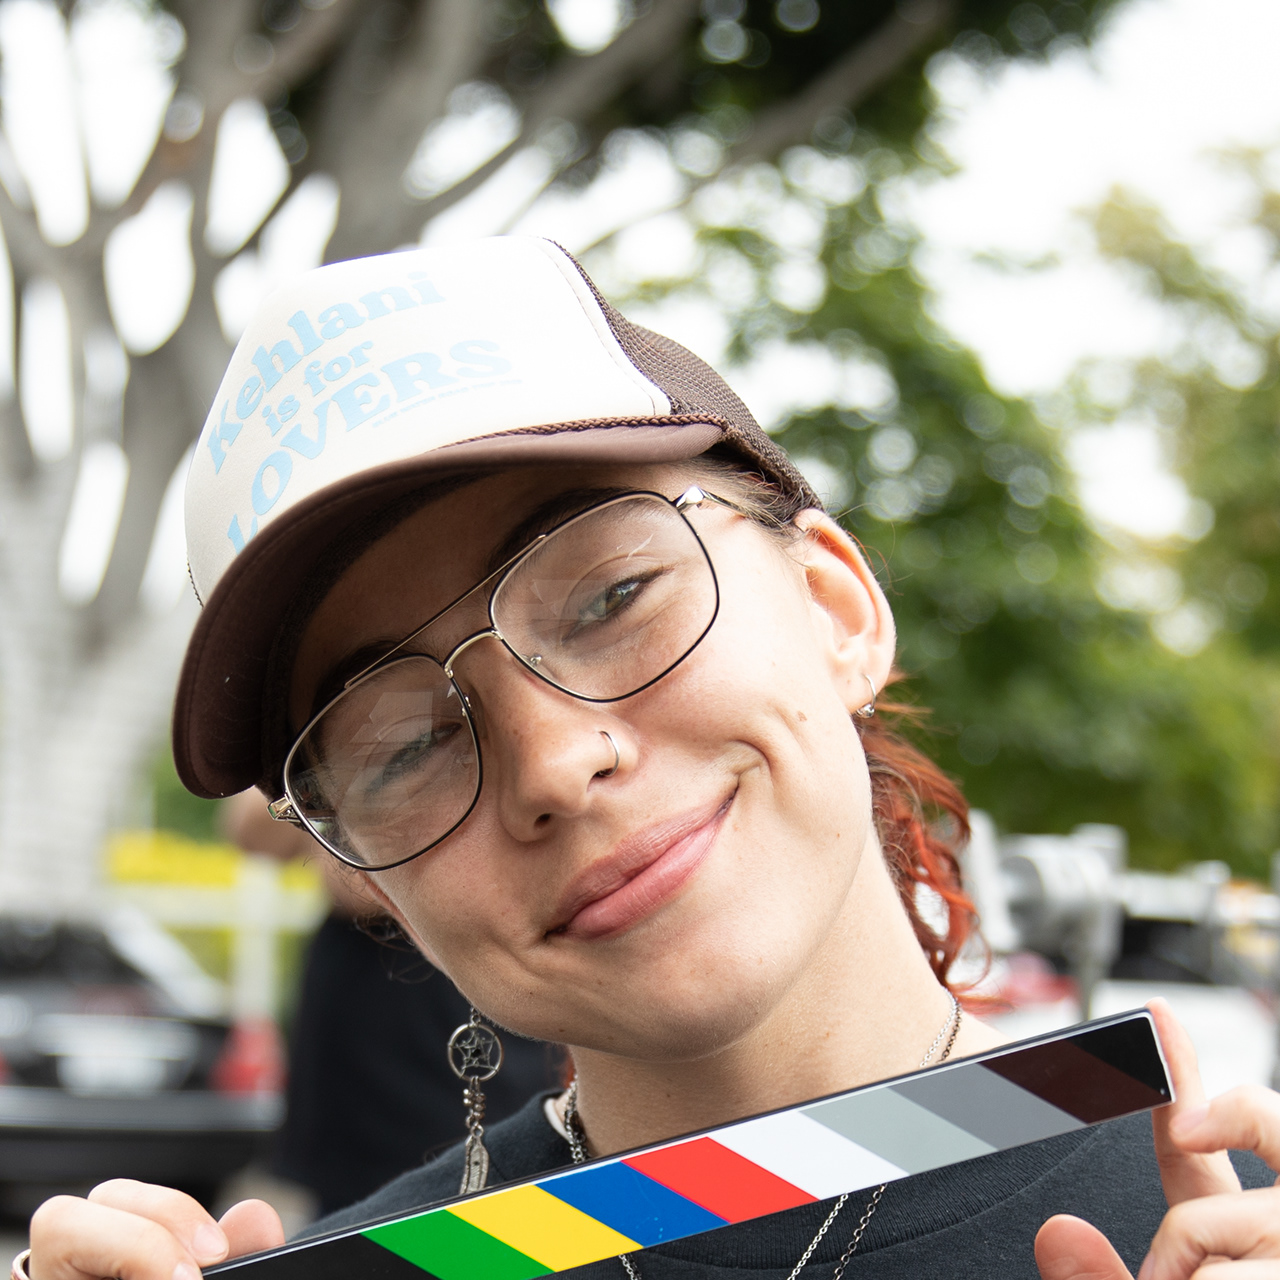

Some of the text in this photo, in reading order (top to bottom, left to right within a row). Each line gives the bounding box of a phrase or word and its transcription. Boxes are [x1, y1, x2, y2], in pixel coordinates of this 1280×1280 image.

[206, 271, 446, 475] Kehlani
[262, 339, 375, 438] is for
